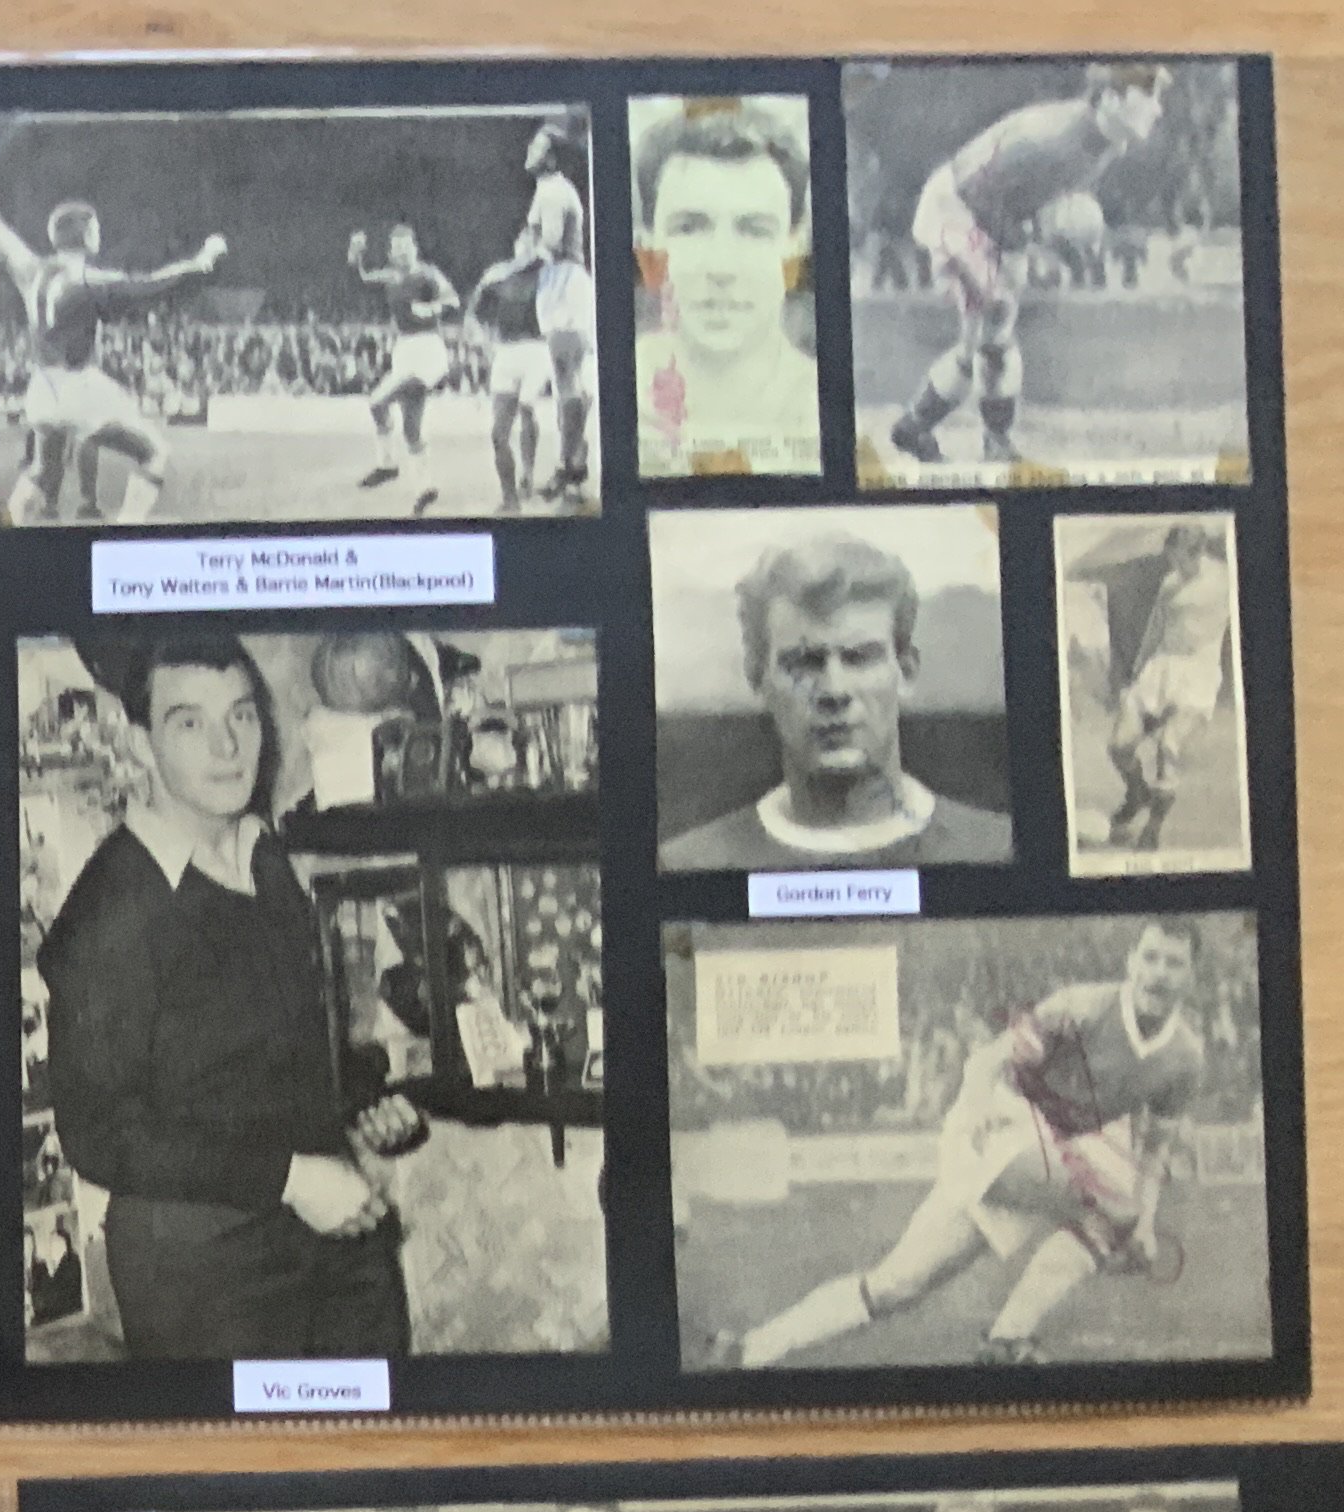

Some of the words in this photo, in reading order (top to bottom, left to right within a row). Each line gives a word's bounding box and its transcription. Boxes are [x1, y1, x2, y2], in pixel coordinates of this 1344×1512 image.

[197, 551, 244, 571] Terry
[251, 550, 339, 567] McDonald
[345, 550, 358, 566] &
[109, 578, 154, 598] Tony
[236, 577, 248, 593] &
[255, 576, 308, 593] Barrie
[777, 885, 841, 902] Gordon
[847, 884, 892, 902] Ferry
[263, 1382, 290, 1400] Vic
[297, 1382, 362, 1400] Groves
